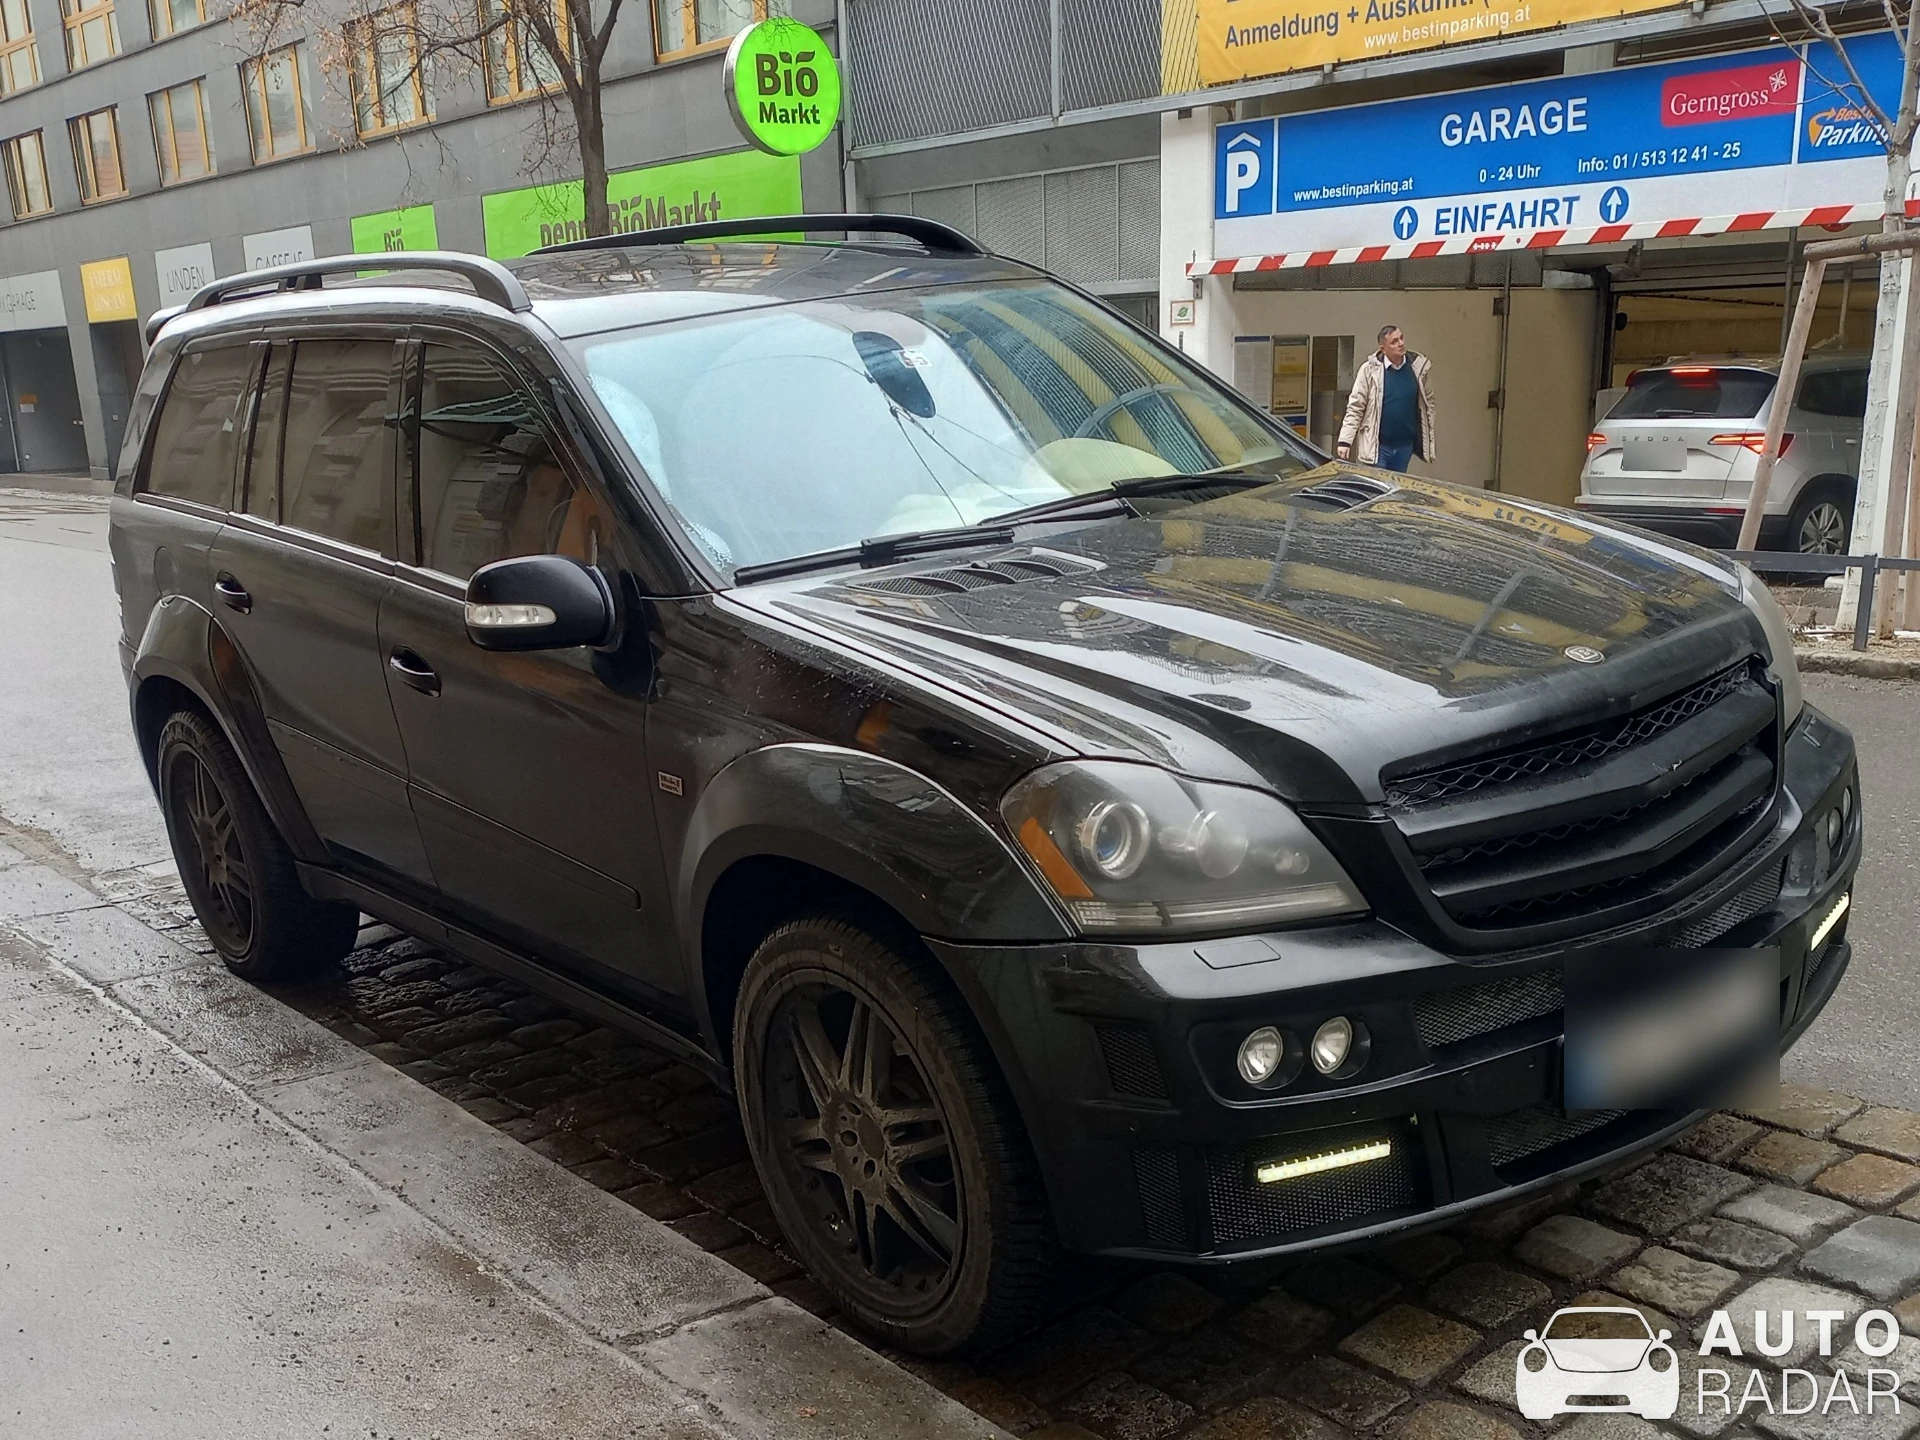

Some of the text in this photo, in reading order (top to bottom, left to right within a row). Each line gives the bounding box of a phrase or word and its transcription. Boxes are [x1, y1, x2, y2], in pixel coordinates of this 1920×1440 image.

[1225, 11, 1339, 49] Anmeldung
[1347, 6, 1359, 23] +
[1364, 4, 1531, 48] www.bestinparking.at
[755, 50, 819, 97] Bio
[759, 101, 821, 124] Markt
[1671, 89, 1769, 116] Gerngross
[1441, 97, 1588, 147] GARAGE
[1479, 169, 1487, 183] 0
[1498, 165, 1514, 181] 24
[1517, 164, 1542, 179] Uhr
[1578, 157, 1608, 173] Info:
[1612, 154, 1628, 170] 01
[1632, 152, 1639, 168] /
[1641, 150, 1666, 167] 513
[1671, 147, 1687, 163] 12
[1691, 145, 1708, 162] 41
[1722, 142, 1741, 159] 25
[1225, 150, 1261, 213] P
[1294, 177, 1413, 201] www.bestinparking.at
[1435, 195, 1581, 236] EINFAHRT
[166, 266, 206, 293] LINDEN
